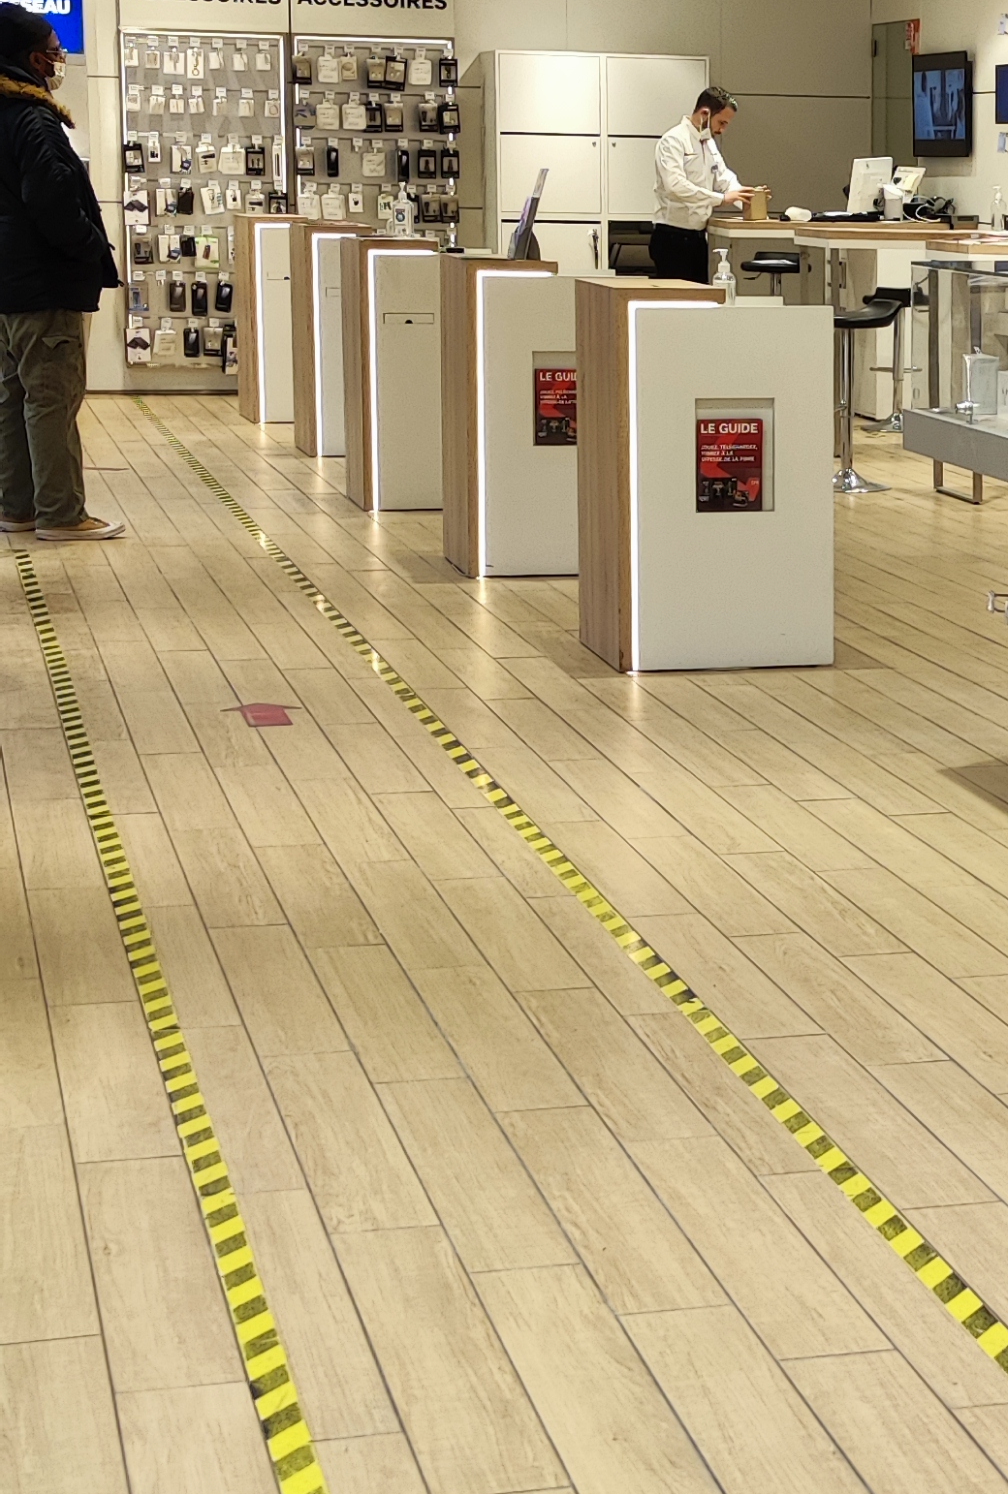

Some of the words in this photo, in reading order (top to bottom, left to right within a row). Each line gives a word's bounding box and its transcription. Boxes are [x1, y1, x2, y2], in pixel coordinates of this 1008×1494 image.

[540, 372, 553, 382] LE
[700, 423, 716, 434] LE
[719, 423, 759, 434] GUIDE
